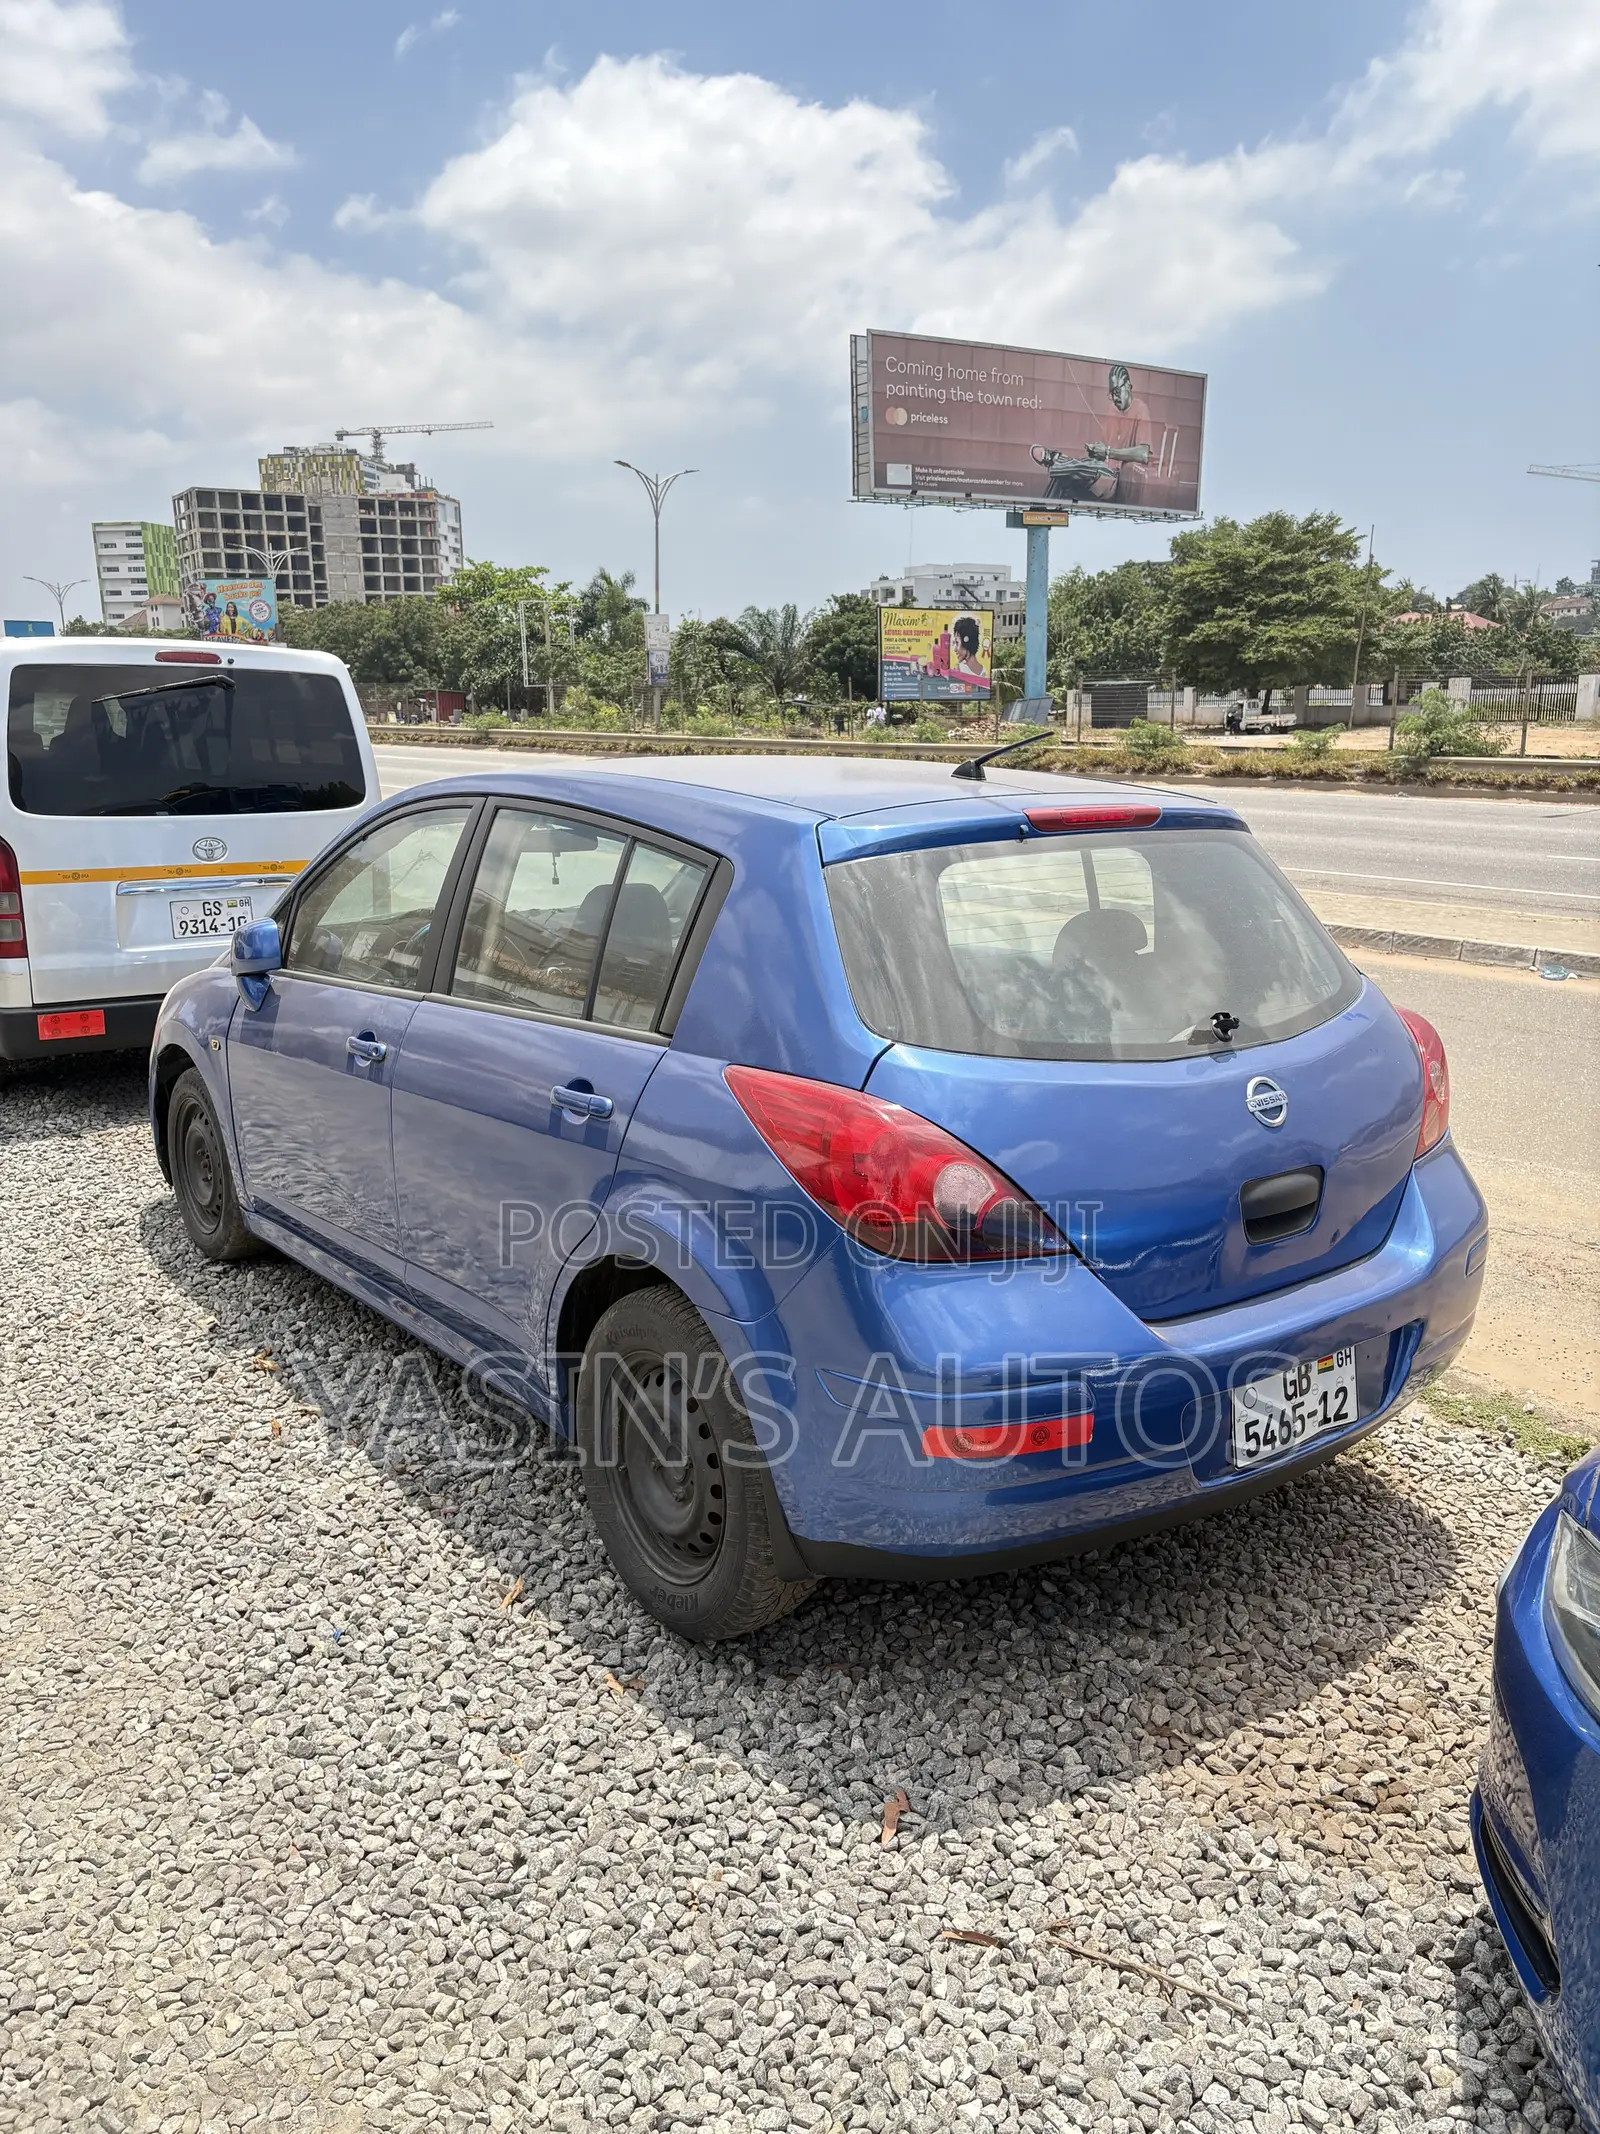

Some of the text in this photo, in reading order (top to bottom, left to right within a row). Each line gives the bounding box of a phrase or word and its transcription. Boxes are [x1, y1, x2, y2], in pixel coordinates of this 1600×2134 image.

[885, 356, 1024, 386] Coming home from
[886, 382, 1042, 410] painting the town red:
[910, 411, 949, 424] priceless
[217, 583, 248, 593] Heaven
[202, 899, 250, 916] GS GH
[1251, 1093, 1287, 1108] NISSAN
[1283, 1347, 1352, 1401] GB GH
[1245, 1386, 1348, 1458] 5465-12
